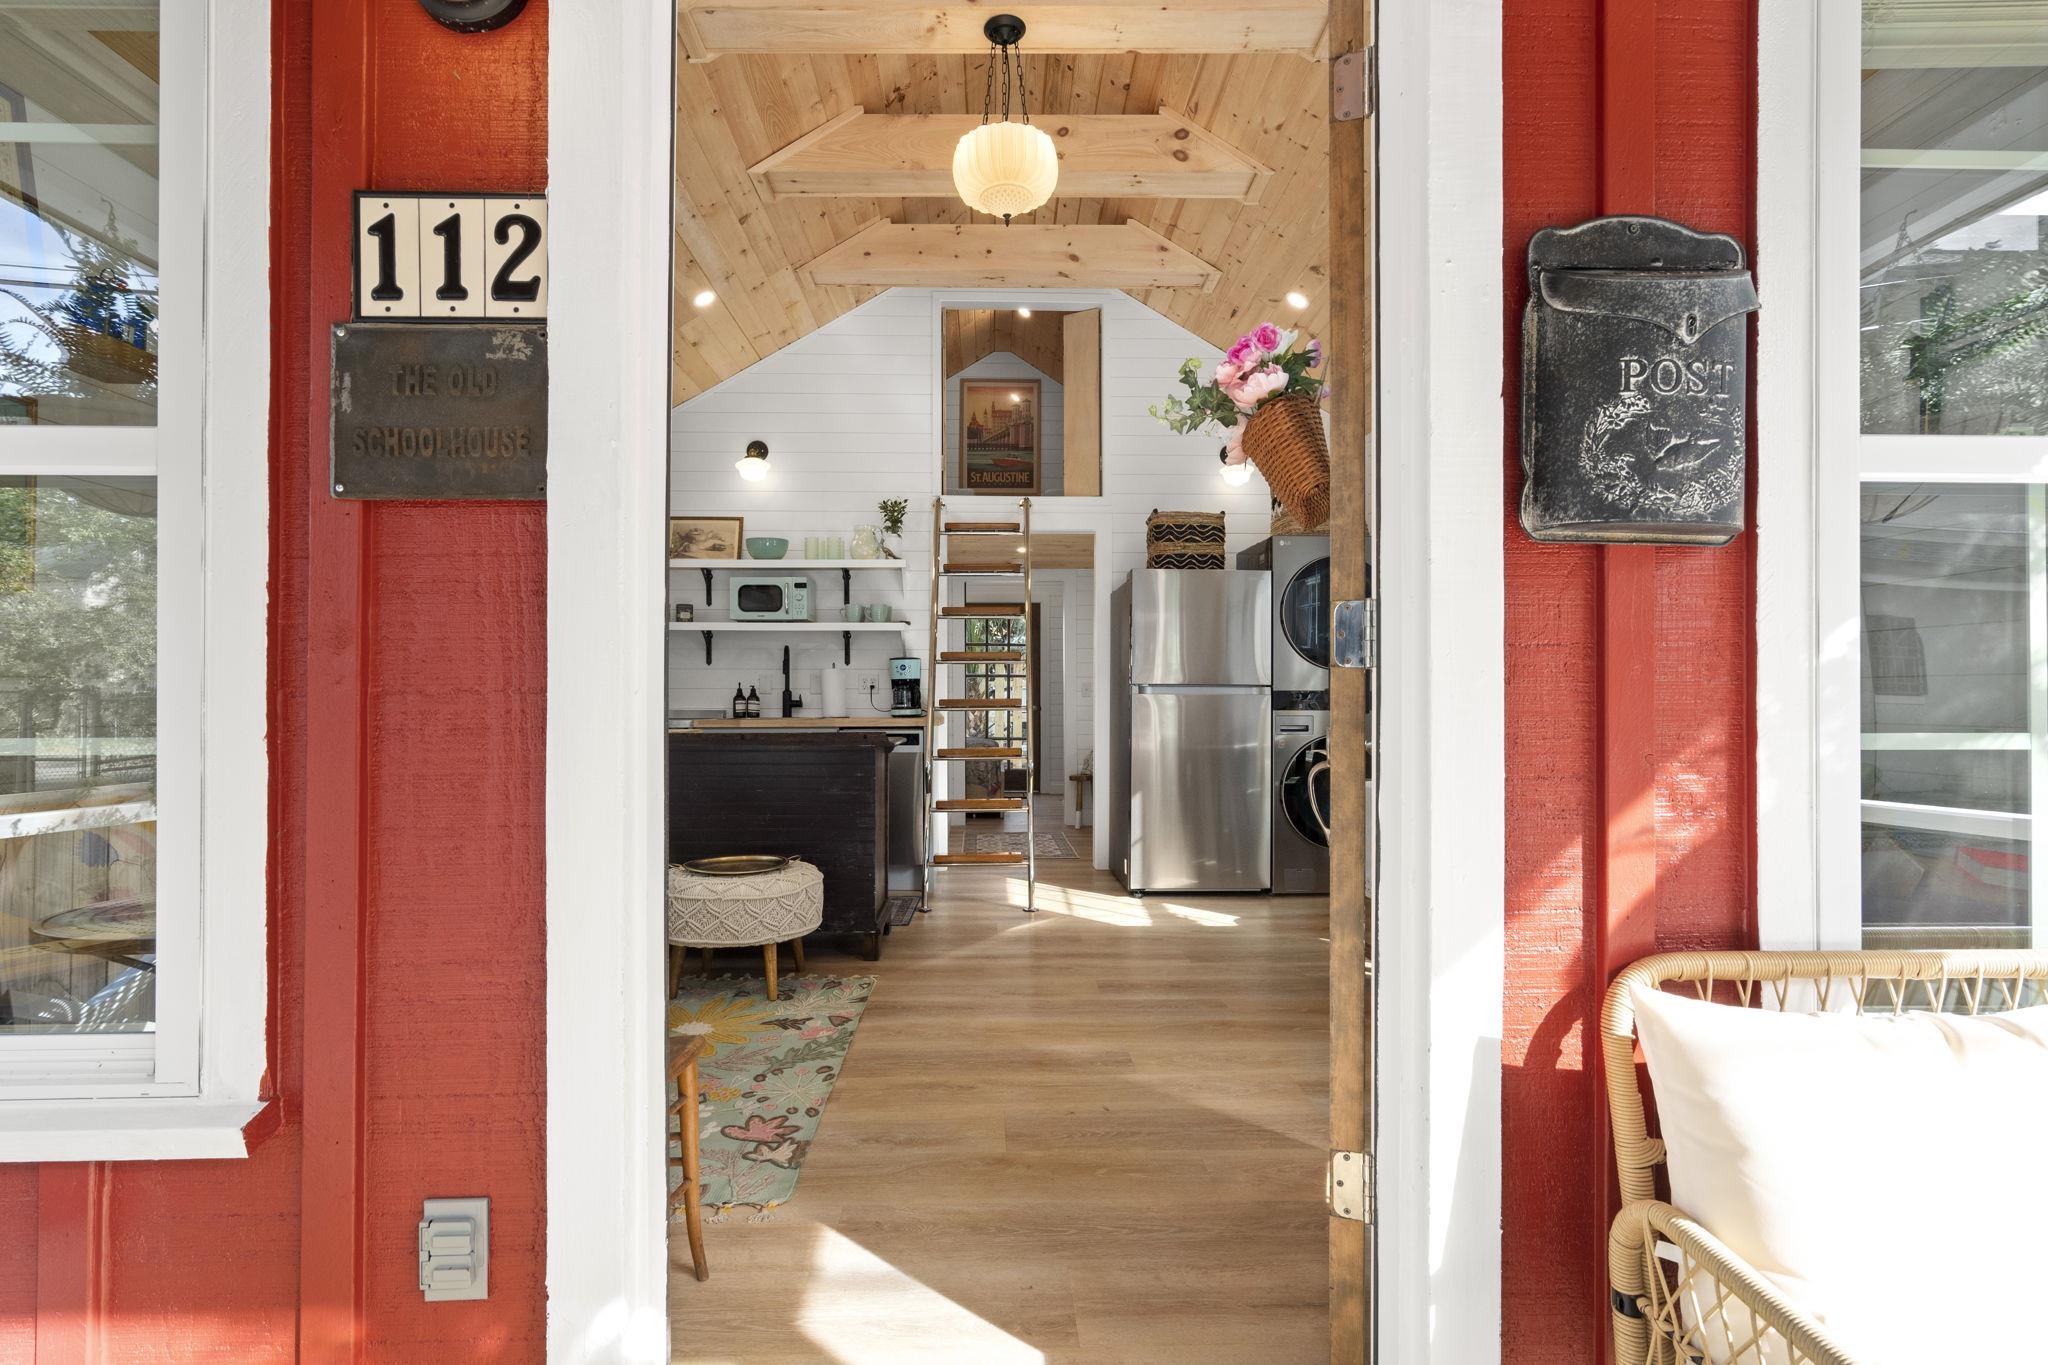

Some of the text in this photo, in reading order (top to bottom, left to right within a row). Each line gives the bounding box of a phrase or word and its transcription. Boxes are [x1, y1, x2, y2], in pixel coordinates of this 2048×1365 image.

[366, 213, 542, 301] 112
[389, 364, 499, 397] THE OLD
[1618, 354, 1735, 398] POST
[351, 427, 532, 458] SCHOOLHOUSE
[982, 471, 1031, 482] AUGUSTINE
